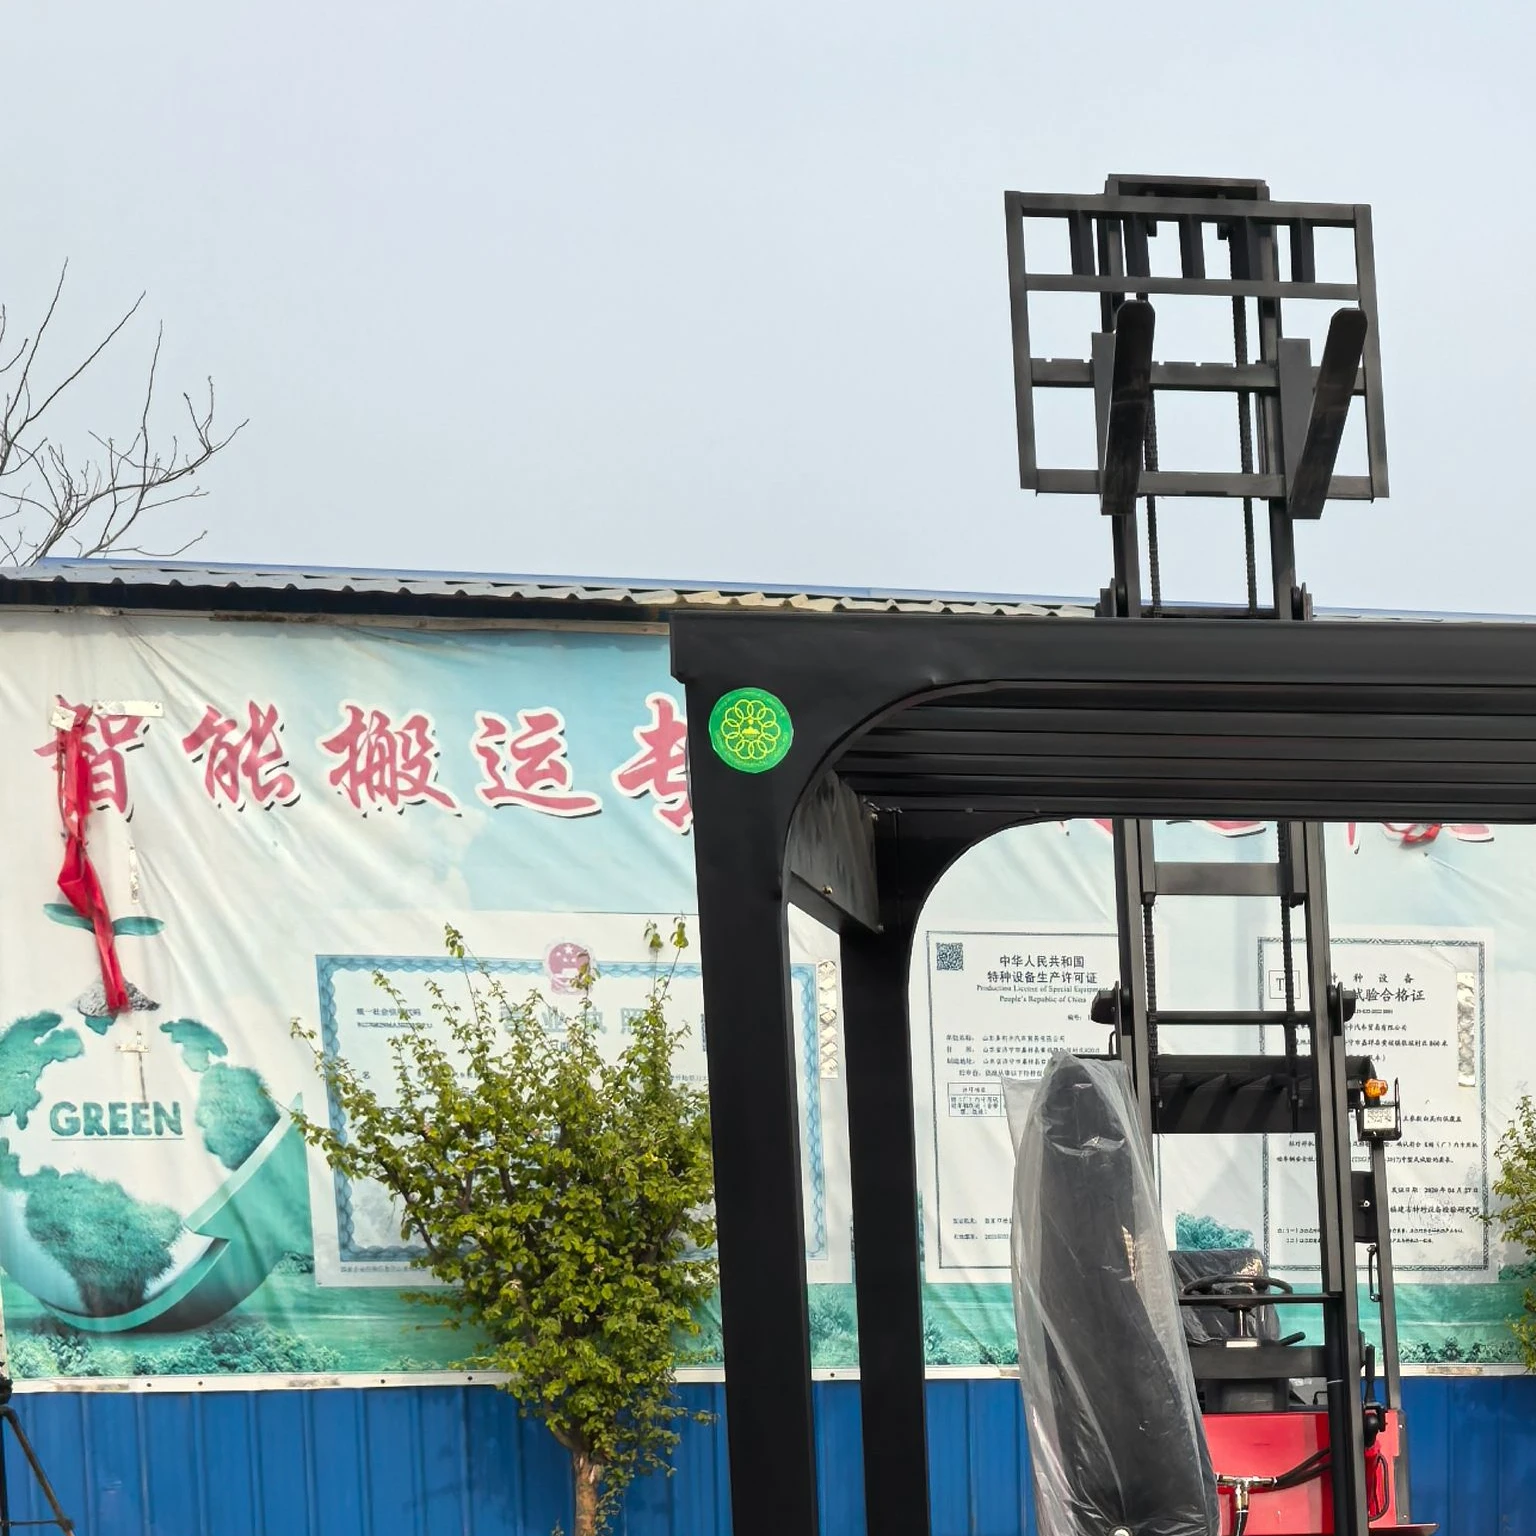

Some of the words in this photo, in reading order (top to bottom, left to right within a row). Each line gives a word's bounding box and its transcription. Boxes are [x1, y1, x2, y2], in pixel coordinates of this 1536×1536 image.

[1000, 955, 1085, 968] 中华人民共和国
[987, 971, 1098, 984] 特种设备生产许可证
[50, 1101, 183, 1136] GREEN
